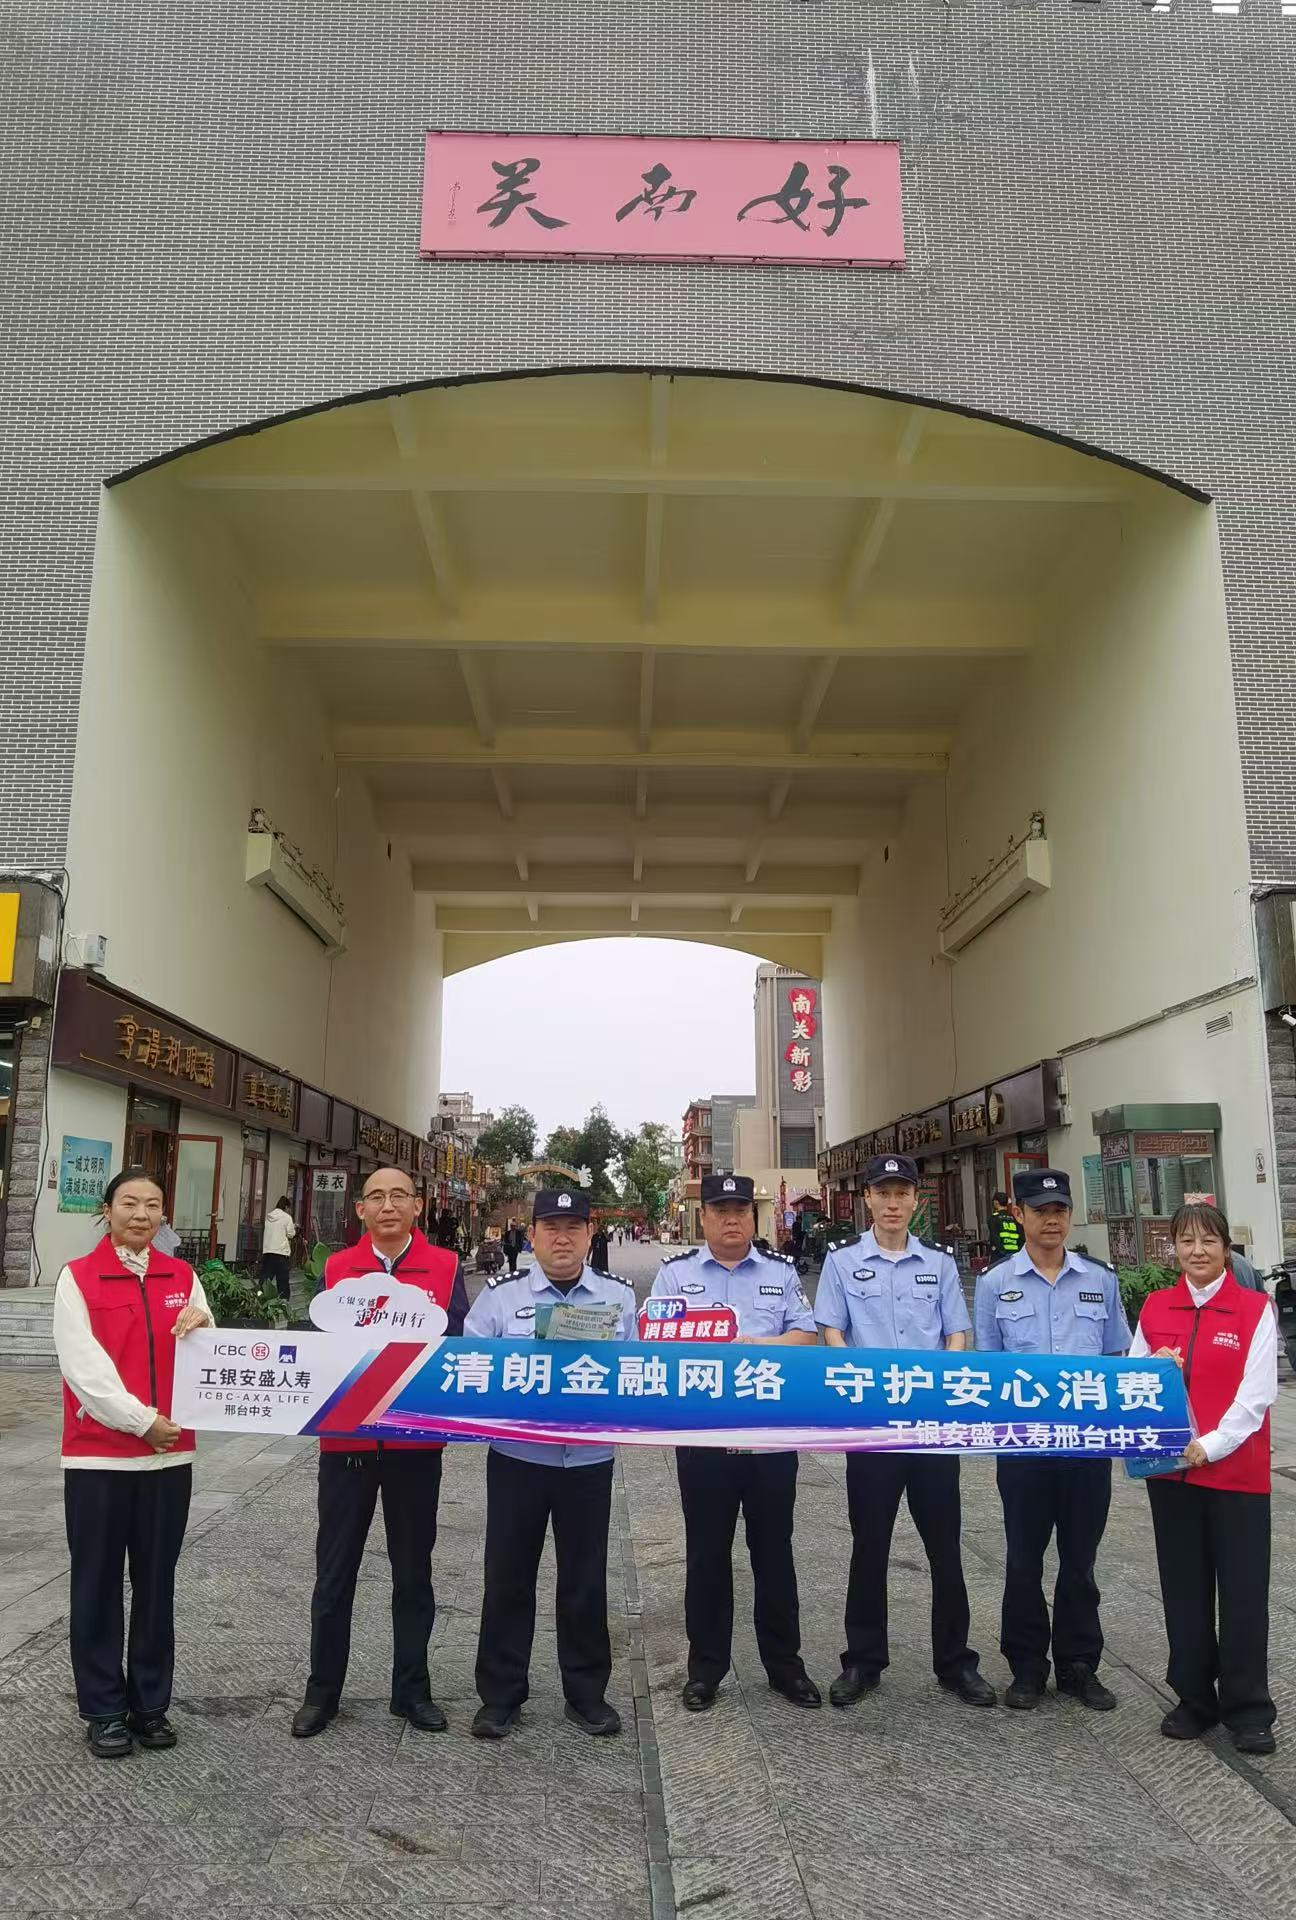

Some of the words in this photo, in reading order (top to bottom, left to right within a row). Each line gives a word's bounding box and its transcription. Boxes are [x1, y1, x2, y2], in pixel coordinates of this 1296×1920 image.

[790, 993, 813, 1093] 南关新影
[316, 1173, 344, 1190] 寿衣
[336, 1295, 376, 1307] 工银安盛
[651, 1301, 683, 1319] 守护
[356, 1308, 426, 1328] 守护同行
[643, 1320, 731, 1339] 消费者权益
[214, 1344, 247, 1356] ICBC
[199, 1367, 312, 1389] 工银安盛人寿
[440, 1351, 787, 1401] 清朗金融网络
[824, 1361, 1166, 1413] 守护安心消费
[199, 1391, 271, 1403] ICBC-AXA
[278, 1394, 310, 1405] LIFE
[223, 1403, 273, 1418] 邢台中支
[887, 1419, 1163, 1451] 工银安盛人寿邢台中支
